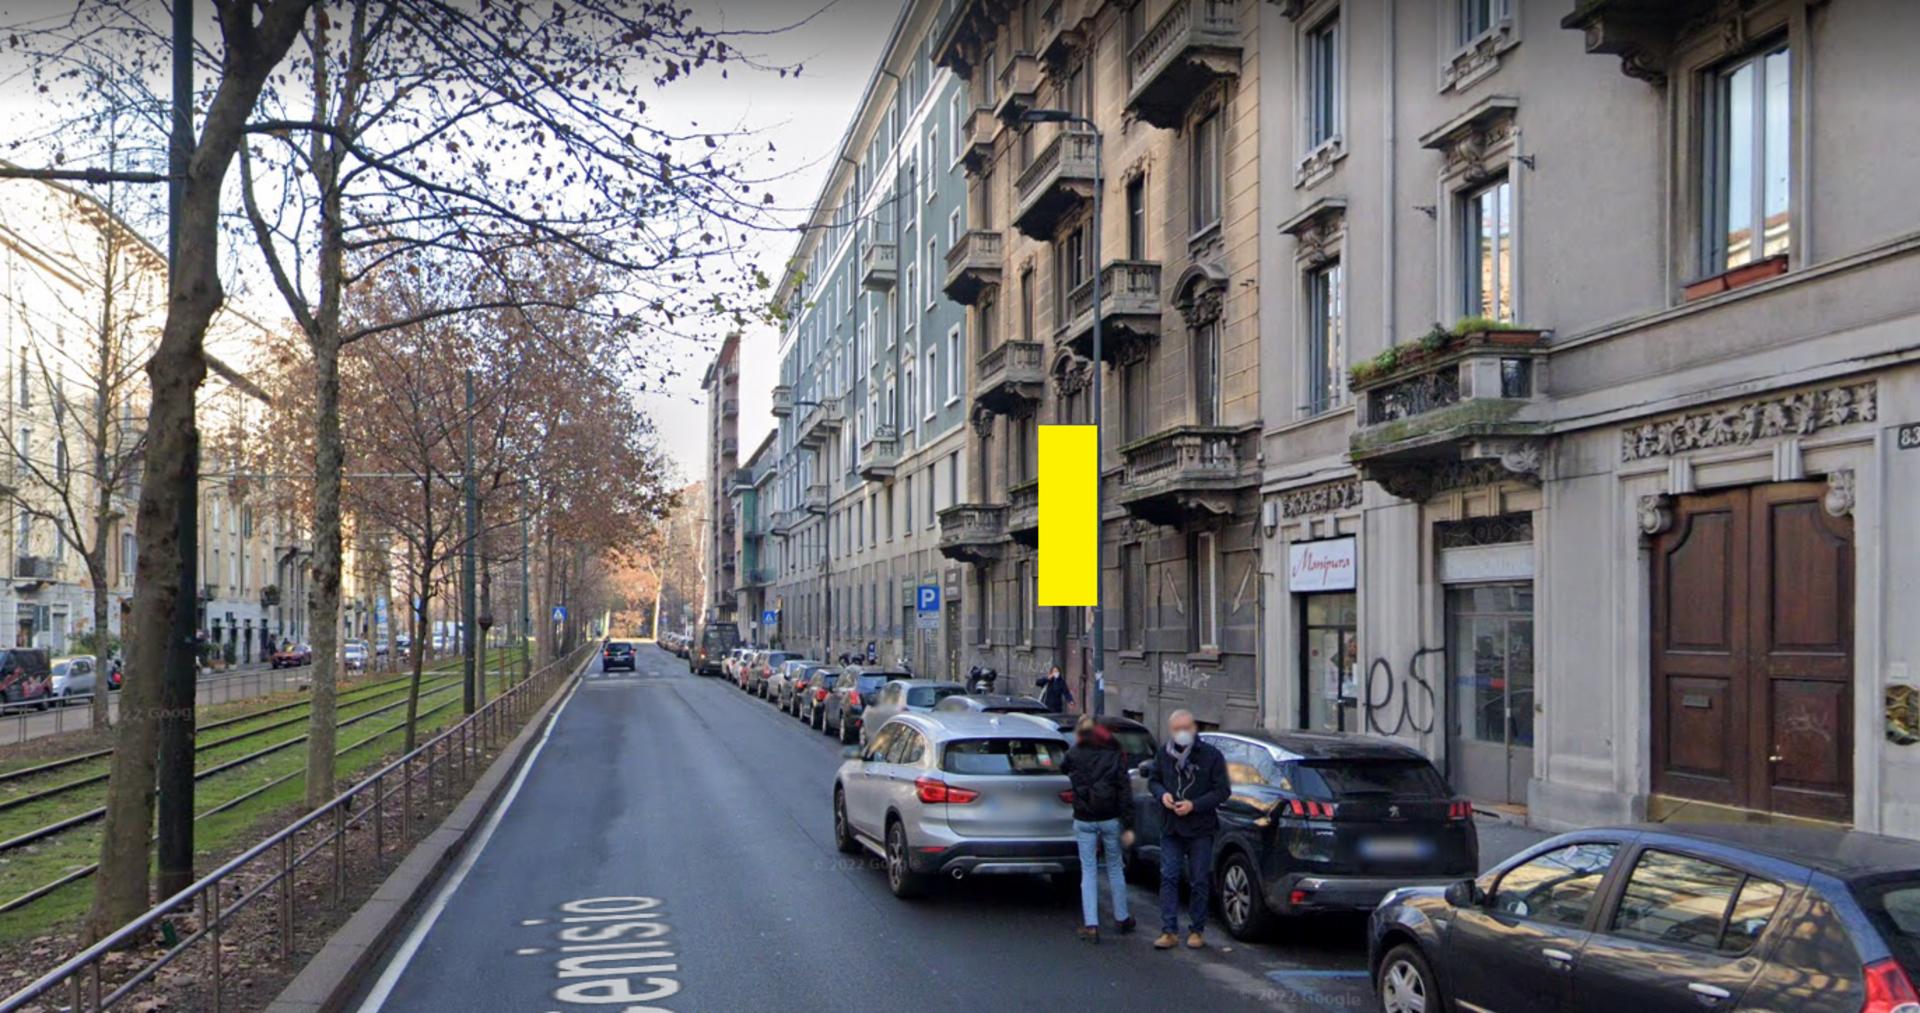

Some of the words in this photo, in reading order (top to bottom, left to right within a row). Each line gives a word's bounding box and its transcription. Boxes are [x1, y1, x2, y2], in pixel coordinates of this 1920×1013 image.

[1901, 426, 1920, 446] 83
[921, 588, 936, 609] P
[516, 896, 682, 1013] enisio
